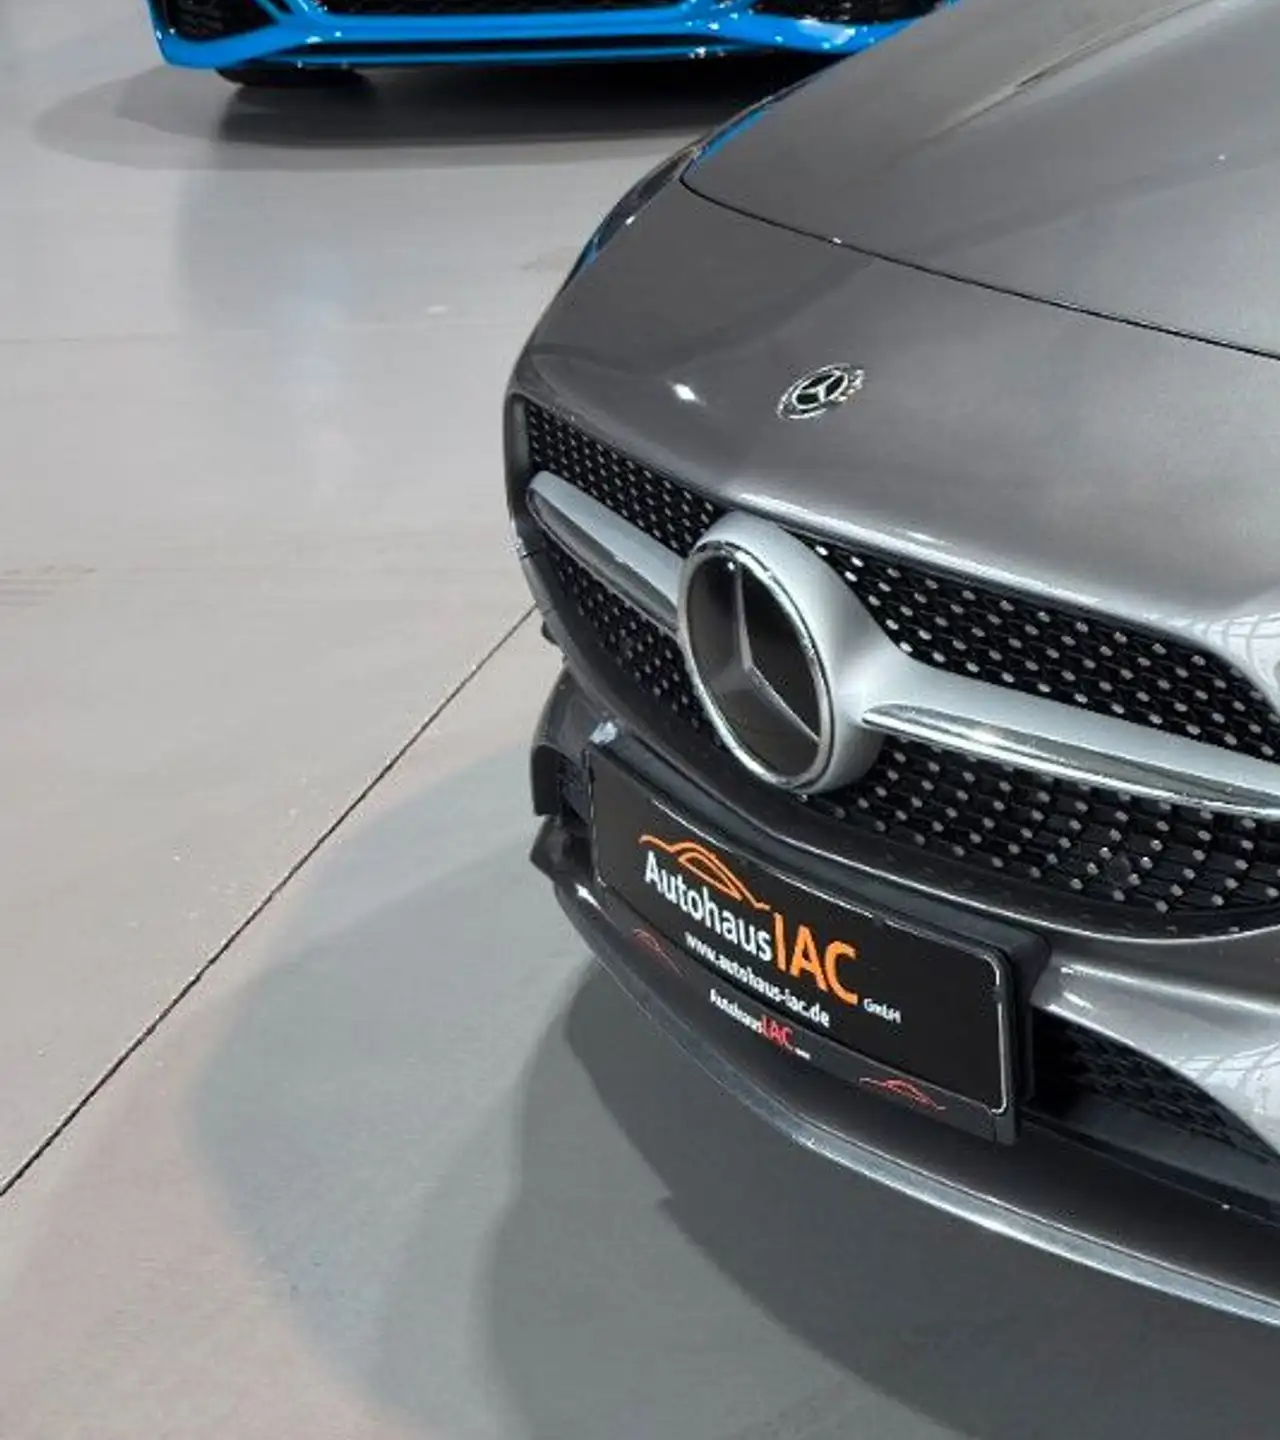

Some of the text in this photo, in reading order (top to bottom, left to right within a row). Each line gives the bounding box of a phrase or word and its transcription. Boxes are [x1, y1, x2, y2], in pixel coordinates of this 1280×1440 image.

[645, 849, 902, 1024] Autohaus IAC GmbH
[684, 931, 831, 1029] www.autohaus-iac.de
